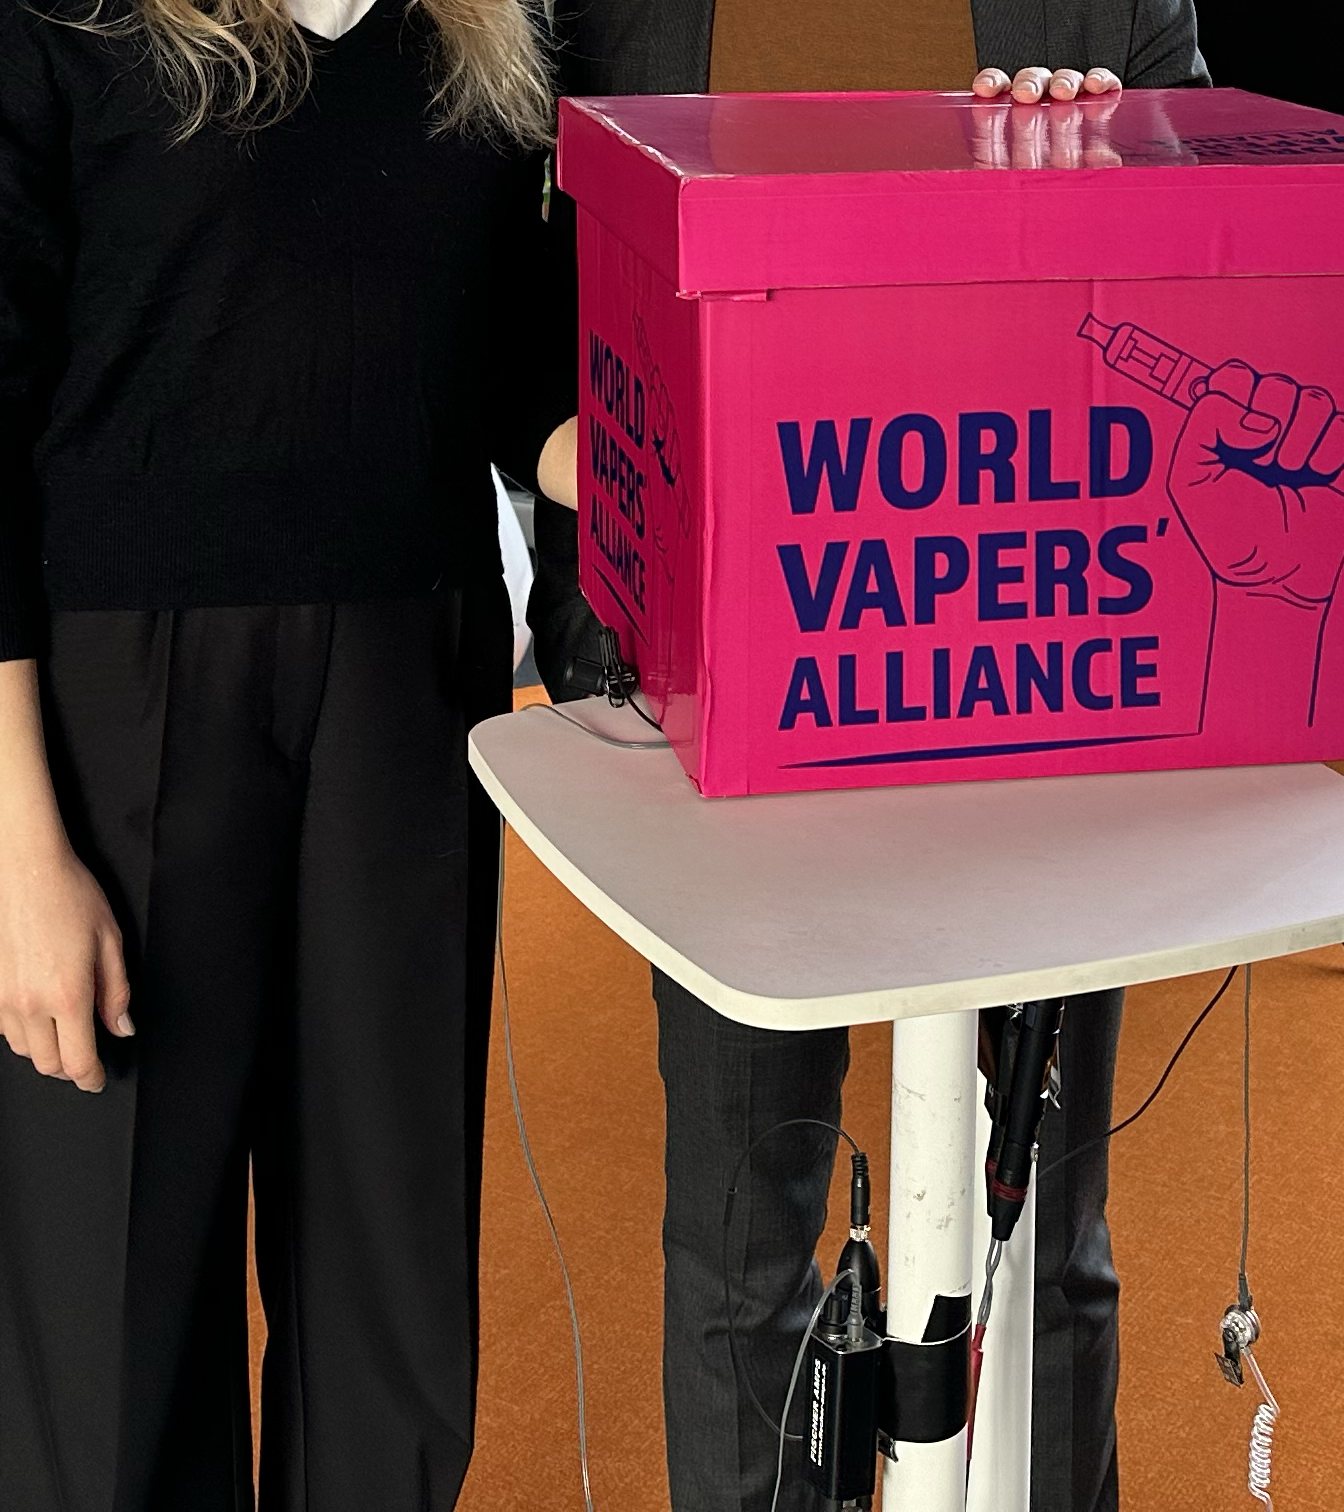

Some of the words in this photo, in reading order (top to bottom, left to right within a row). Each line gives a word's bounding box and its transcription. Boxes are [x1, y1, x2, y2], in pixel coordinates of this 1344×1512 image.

[589, 329, 646, 451] WORLD
[776, 405, 1154, 515] WORLD
[590, 492, 646, 615] ALLIANCE
[776, 517, 1170, 633] VAPERS'
[778, 635, 1161, 731] ALLIANCE
[810, 1400, 819, 1463] FISCHER
[813, 1358, 821, 1400] AMPS
